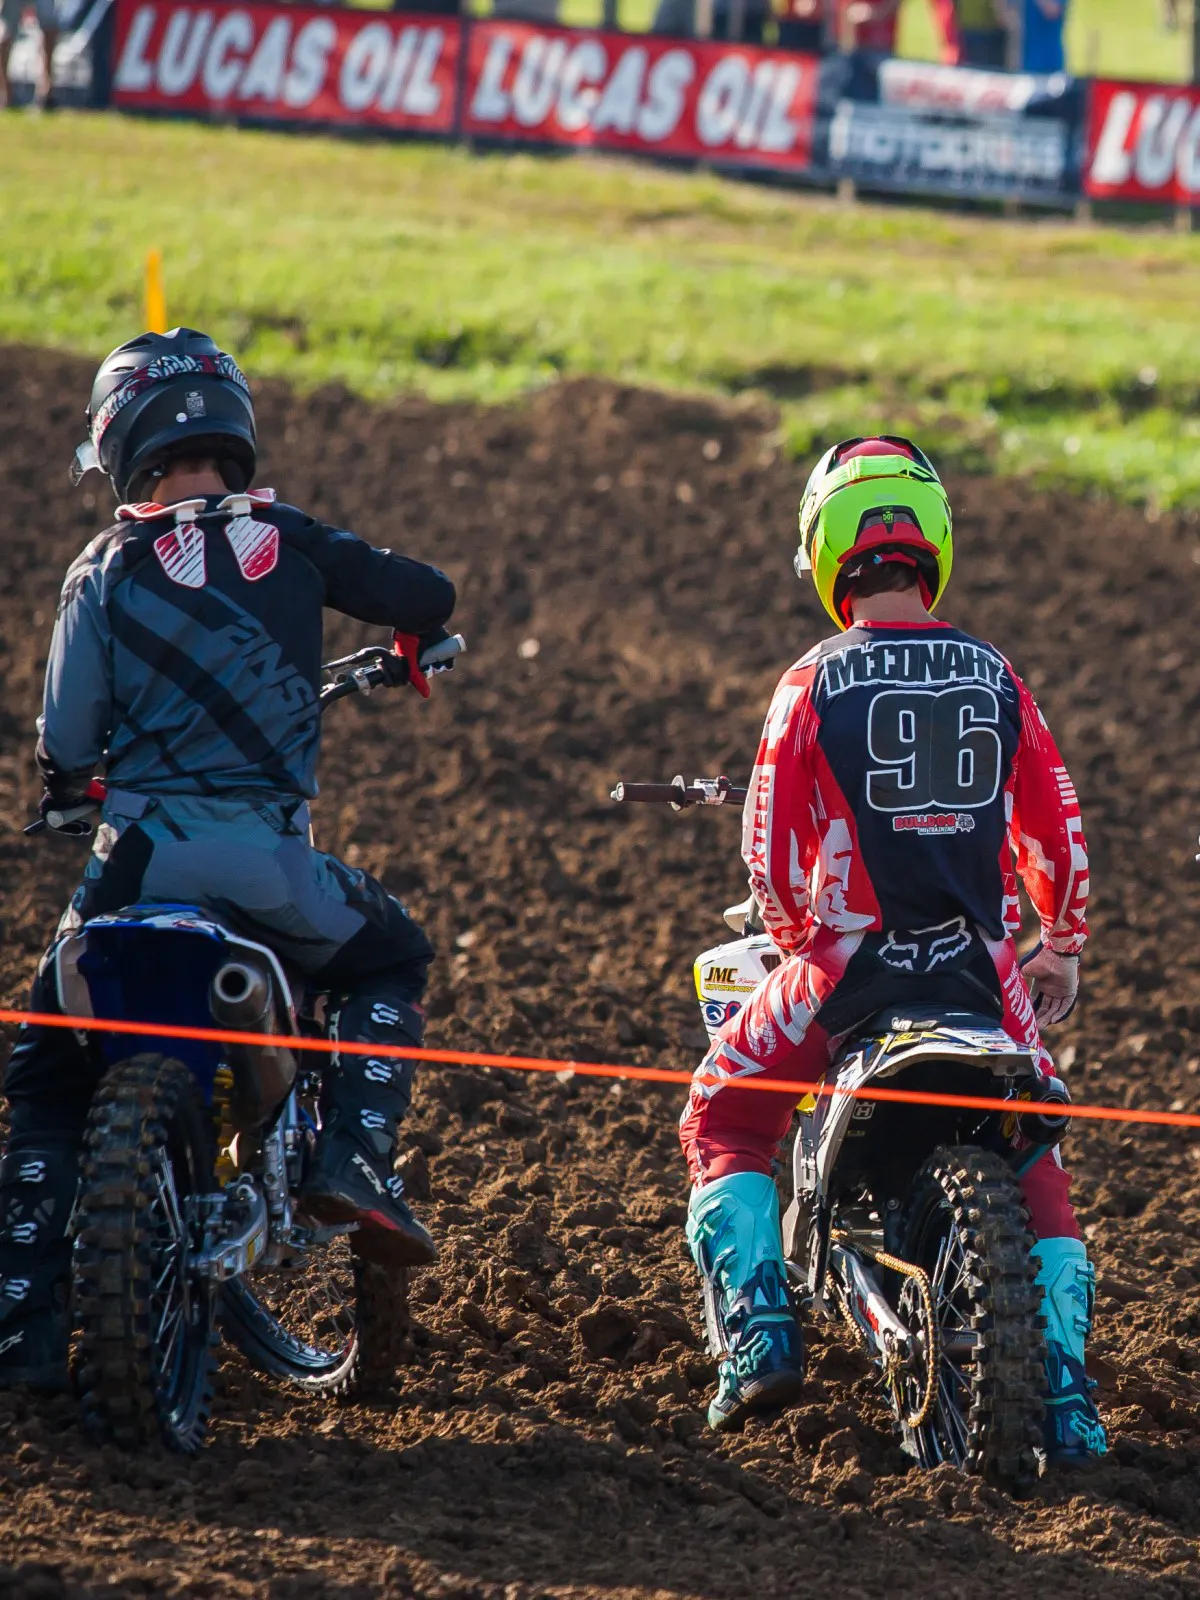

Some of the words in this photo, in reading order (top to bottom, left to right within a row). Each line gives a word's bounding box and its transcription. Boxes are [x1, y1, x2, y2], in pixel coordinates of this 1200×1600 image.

[115, 7, 338, 108] LUCAS
[339, 22, 445, 117] OIL
[471, 34, 696, 142] LUCAS
[696, 54, 802, 154] OIL
[867, 685, 1001, 812] 96
[894, 814, 956, 830] BULLDOG
[704, 967, 738, 984] JMC
[352, 1152, 386, 1195] TCX
